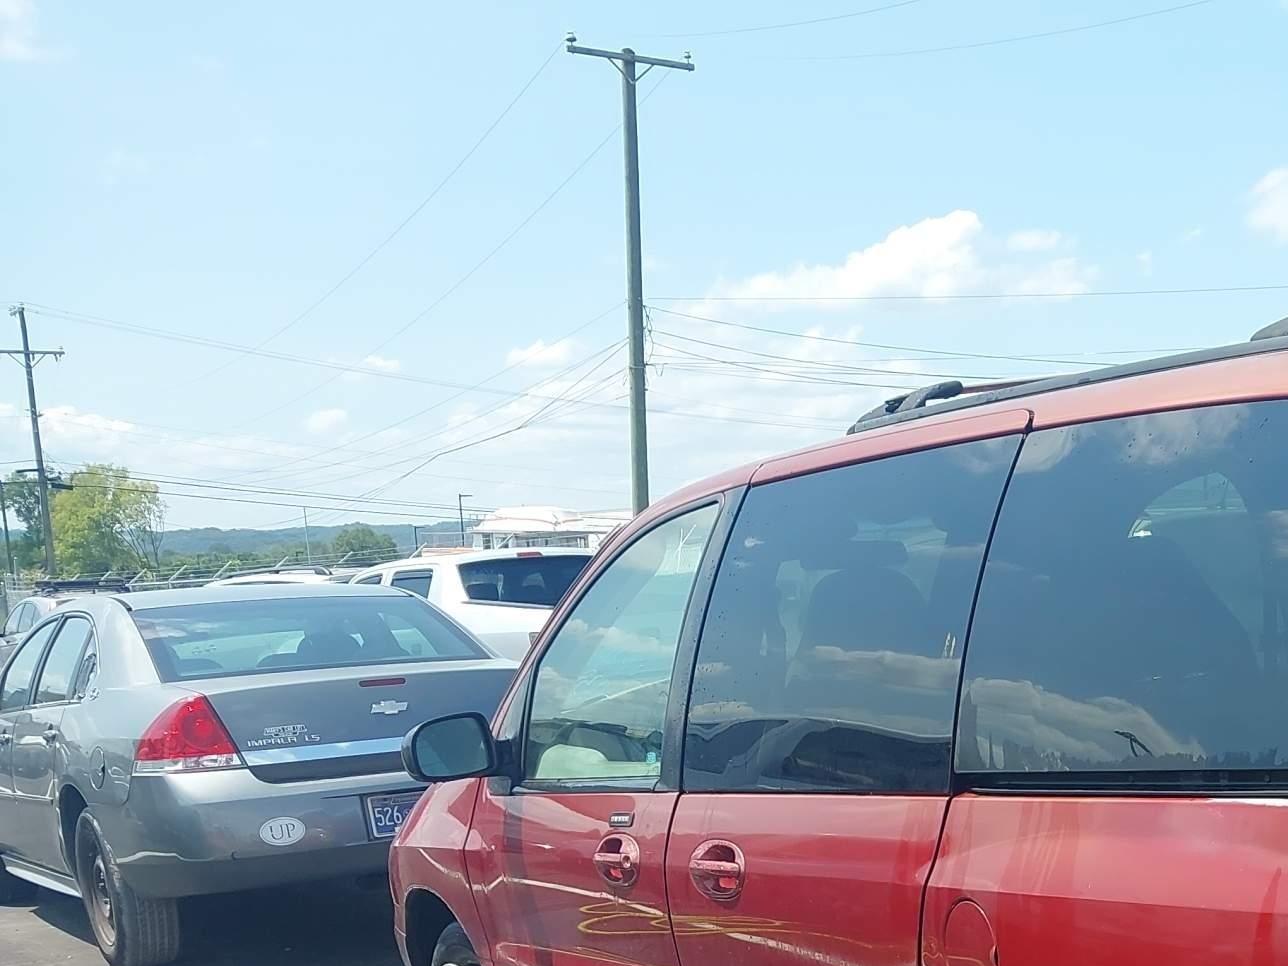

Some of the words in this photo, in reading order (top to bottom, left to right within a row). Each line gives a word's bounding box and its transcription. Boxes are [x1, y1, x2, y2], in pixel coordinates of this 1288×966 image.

[246, 735, 298, 747] IMPALA
[304, 734, 320, 742] LS
[269, 823, 296, 841] UP
